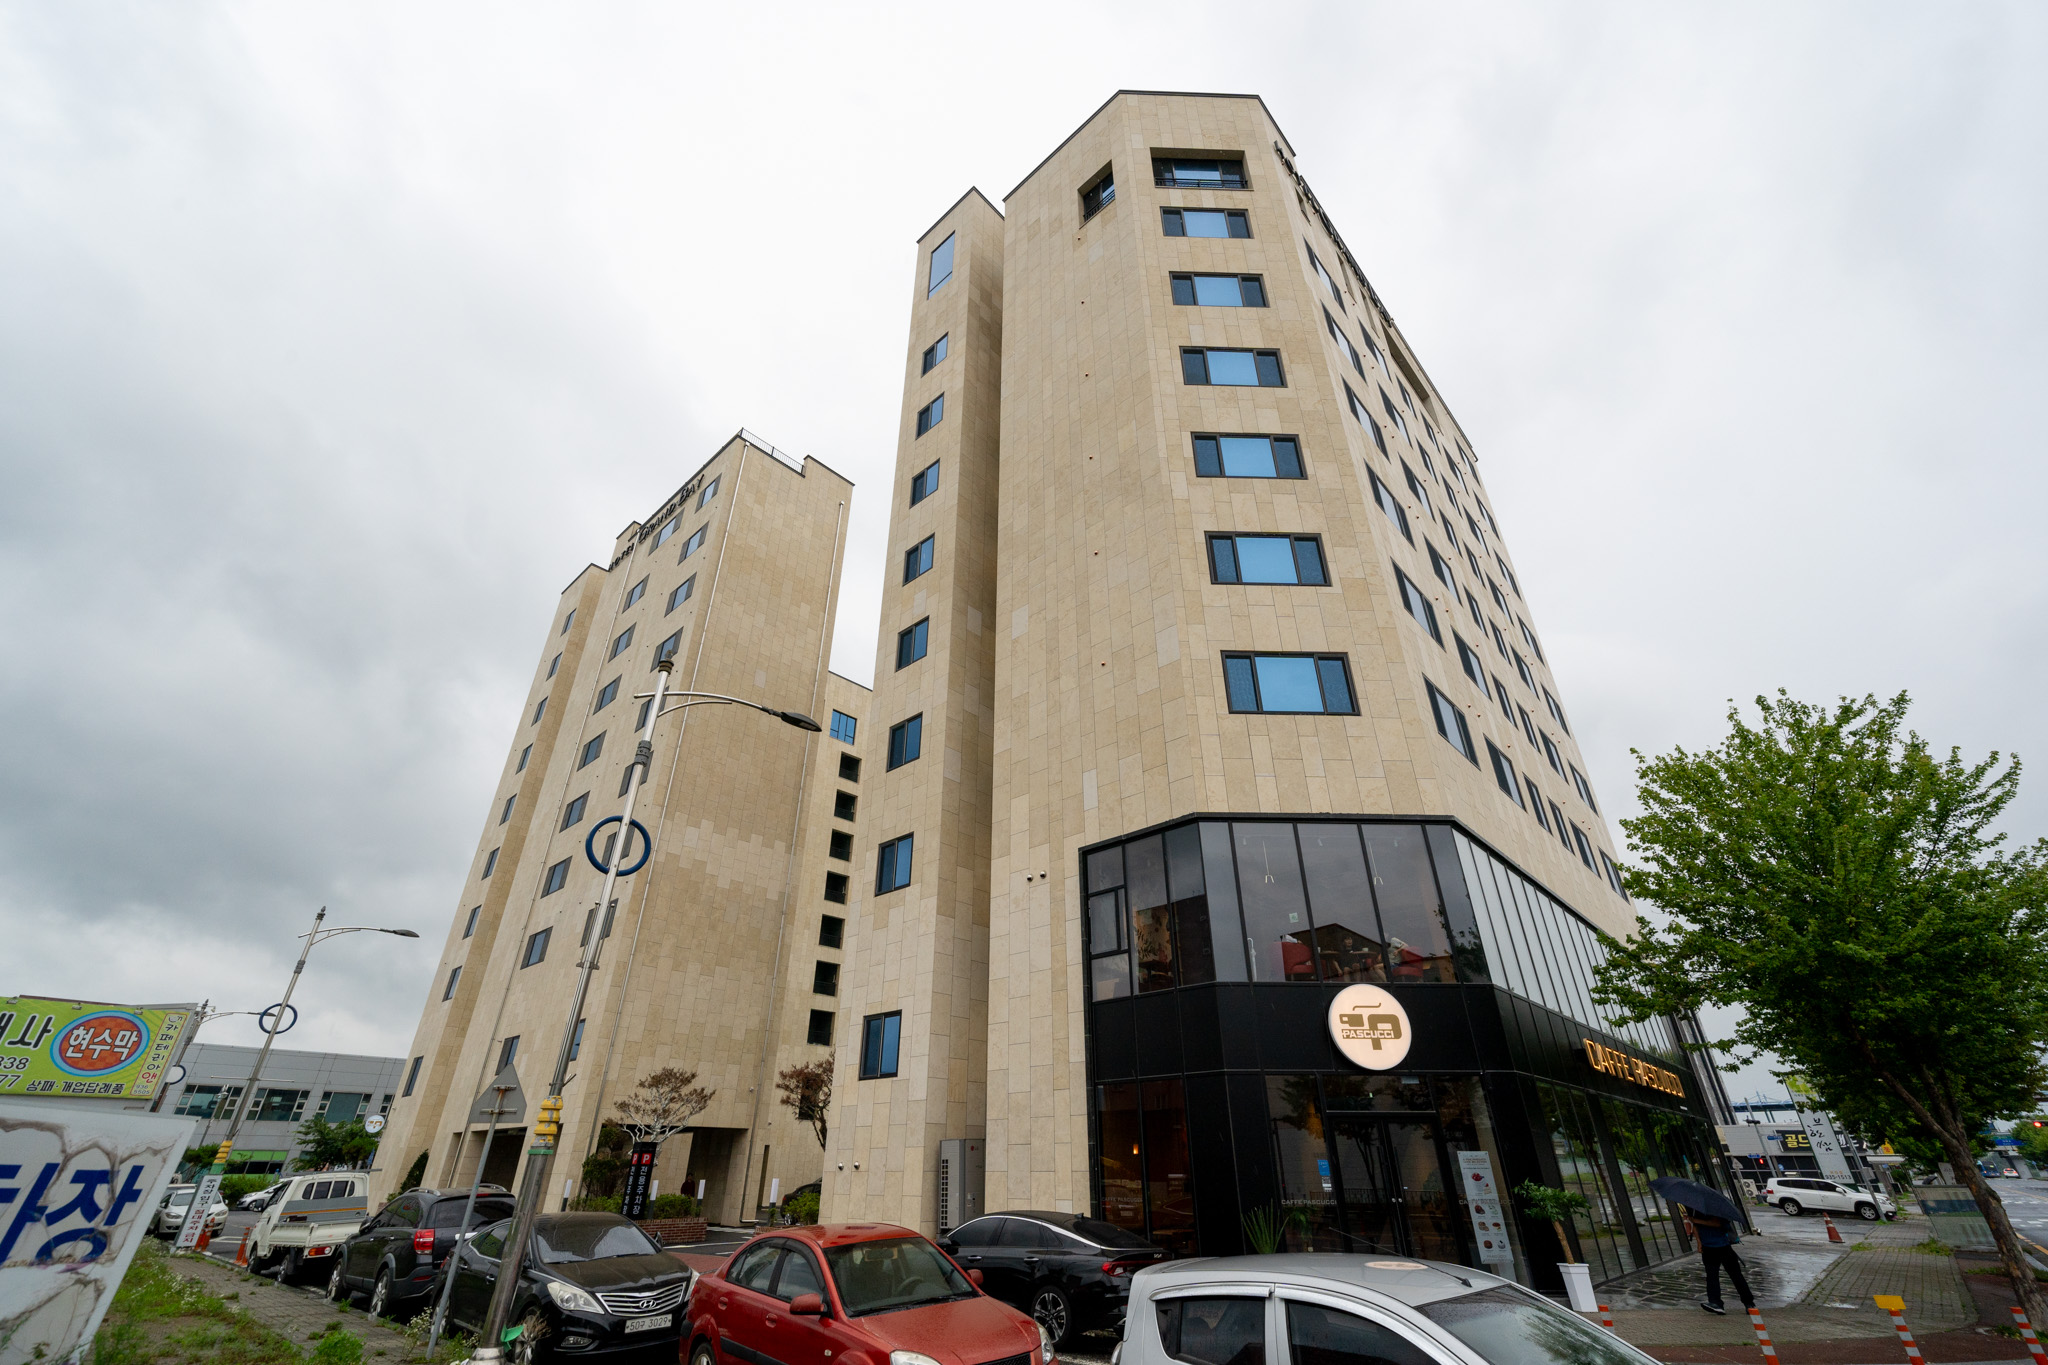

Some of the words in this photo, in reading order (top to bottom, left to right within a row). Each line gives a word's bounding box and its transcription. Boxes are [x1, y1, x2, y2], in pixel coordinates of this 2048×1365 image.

[65, 1026, 139, 1061] 현수막
[1343, 1029, 1395, 1039] PASCUCCI
[632, 1166, 648, 1215] 전용주차장
[648, 1316, 669, 1328] 3029
